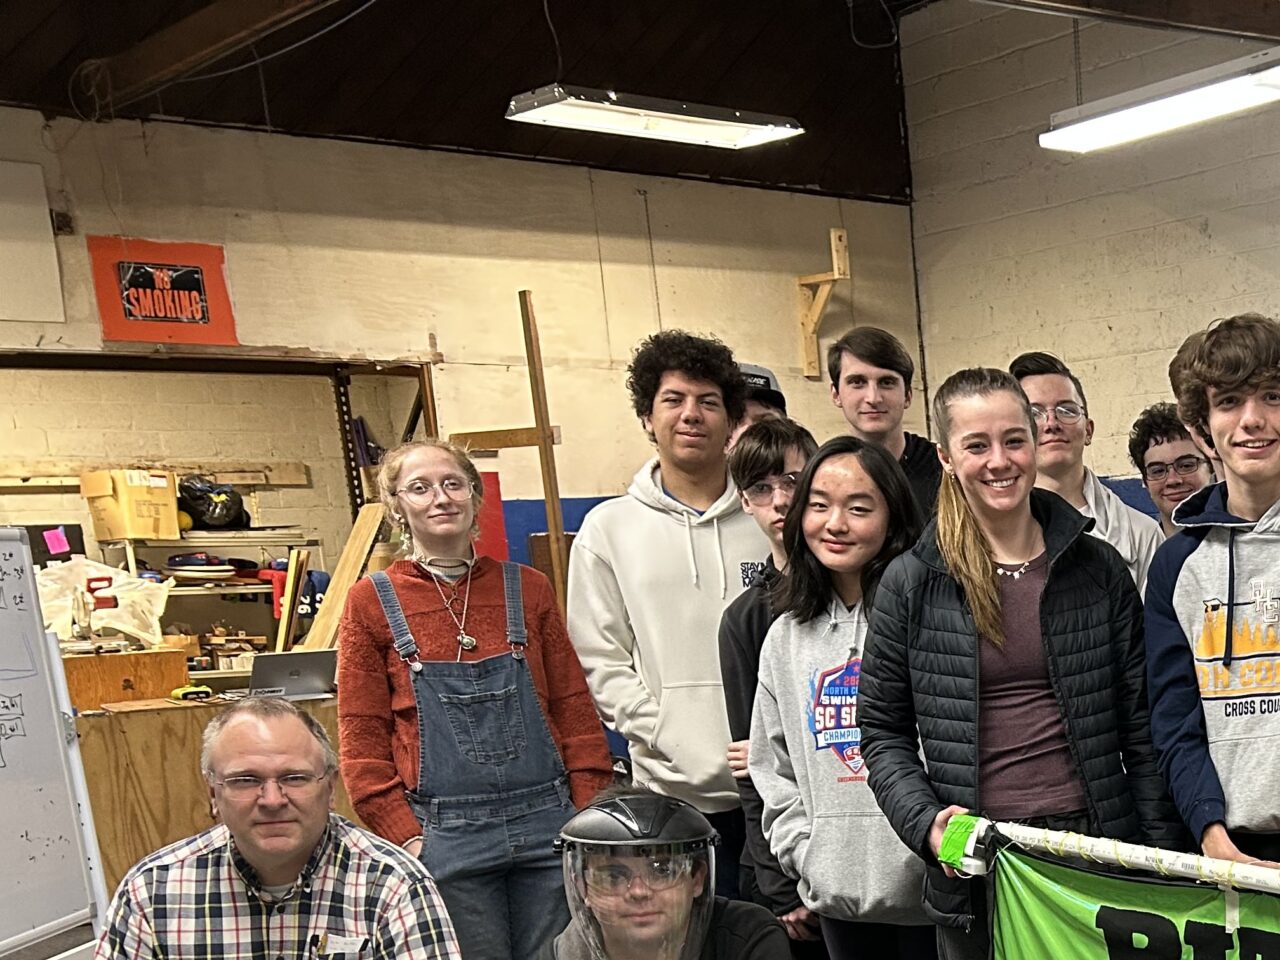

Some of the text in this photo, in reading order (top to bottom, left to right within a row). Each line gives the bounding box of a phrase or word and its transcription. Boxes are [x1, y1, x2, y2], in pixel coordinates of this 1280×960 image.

[153, 268, 172, 289] NO
[128, 287, 203, 320] SMOKING
[815, 706, 836, 730] SC
[1224, 701, 1256, 717] CROSS
